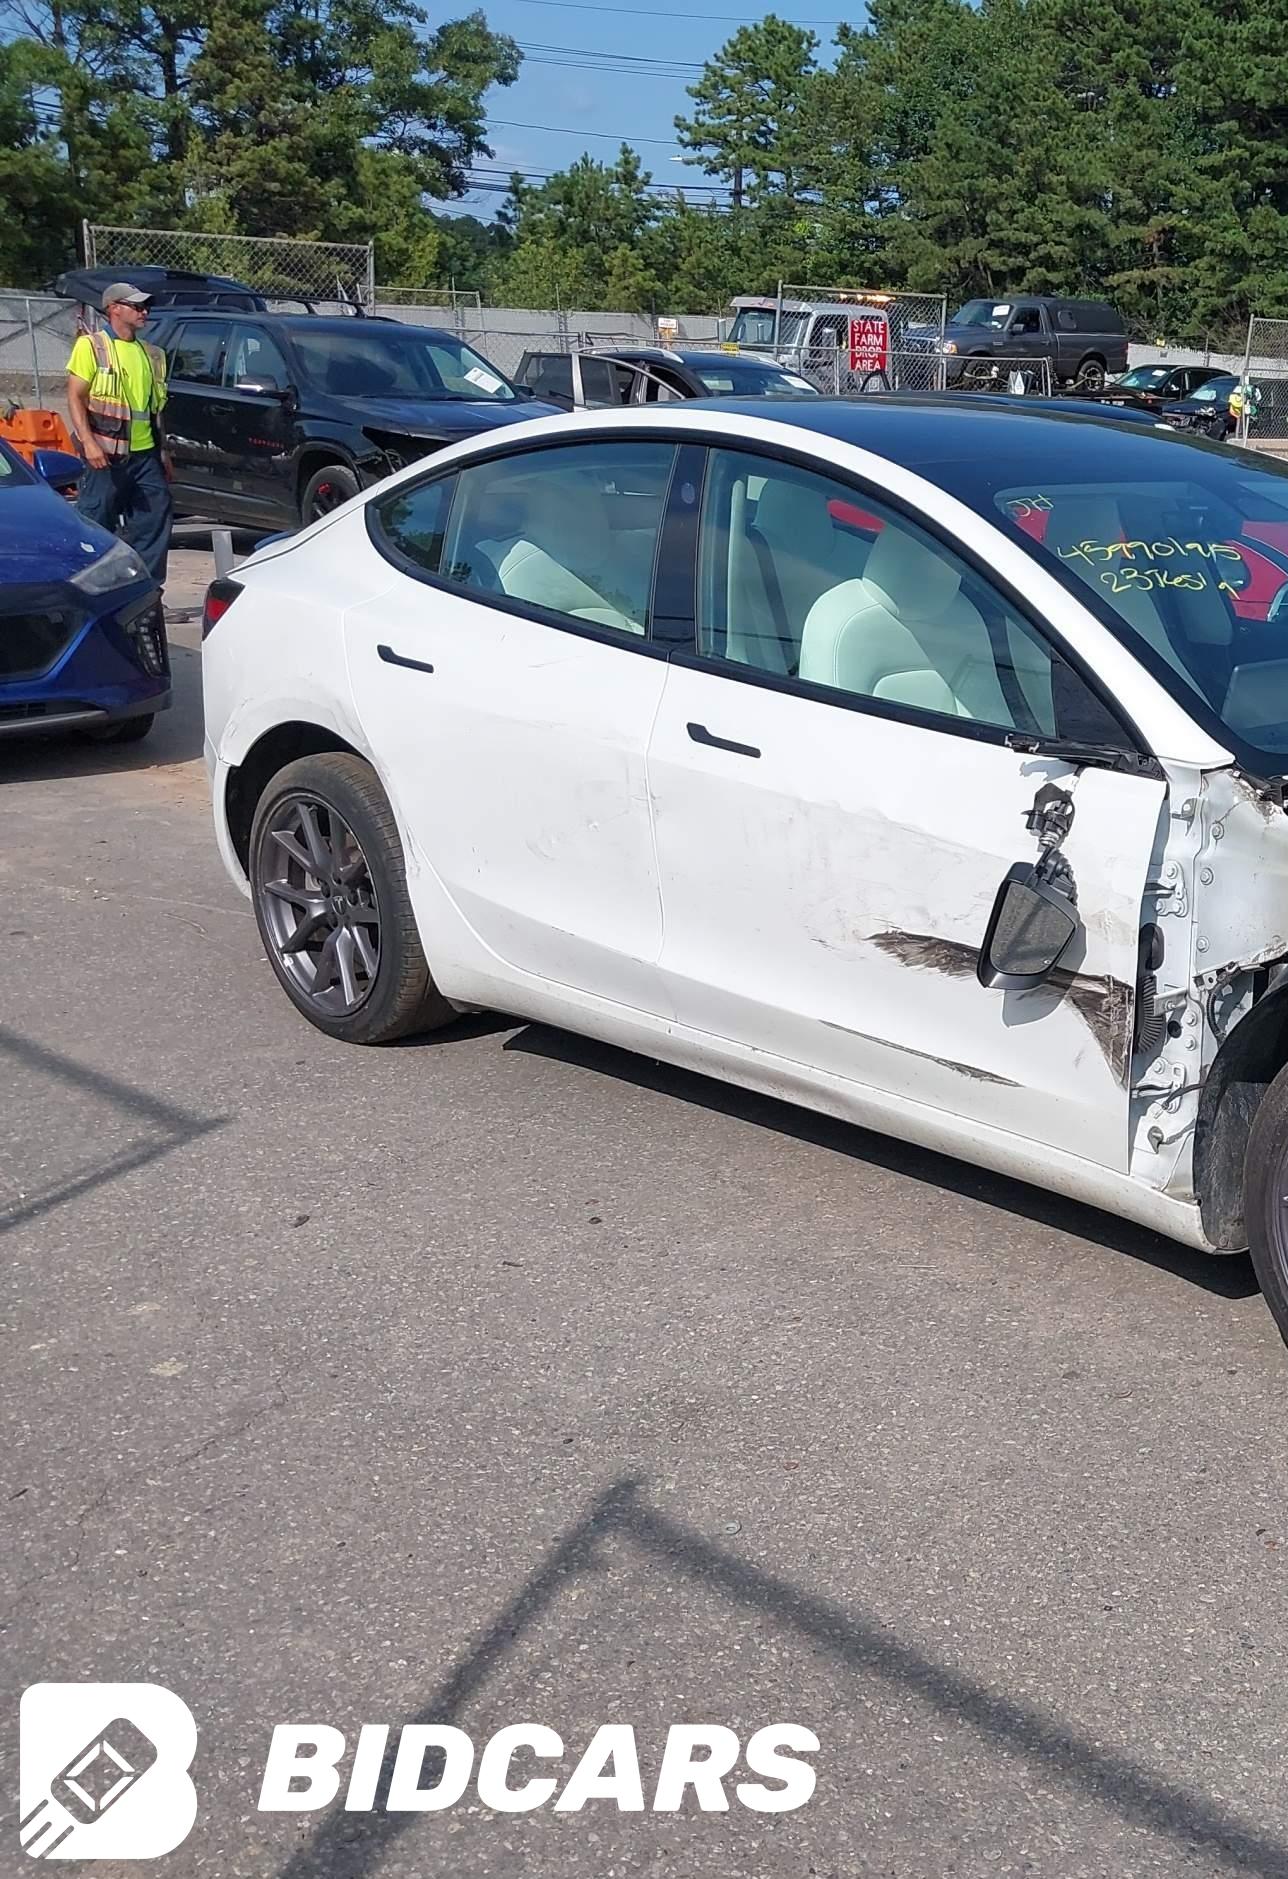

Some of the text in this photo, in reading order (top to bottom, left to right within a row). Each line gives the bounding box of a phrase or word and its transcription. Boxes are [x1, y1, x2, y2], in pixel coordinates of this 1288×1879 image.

[853, 320, 885, 333] STATE
[854, 333, 883, 346] FARM
[855, 345, 882, 359] DROP
[854, 359, 881, 371] AREA
